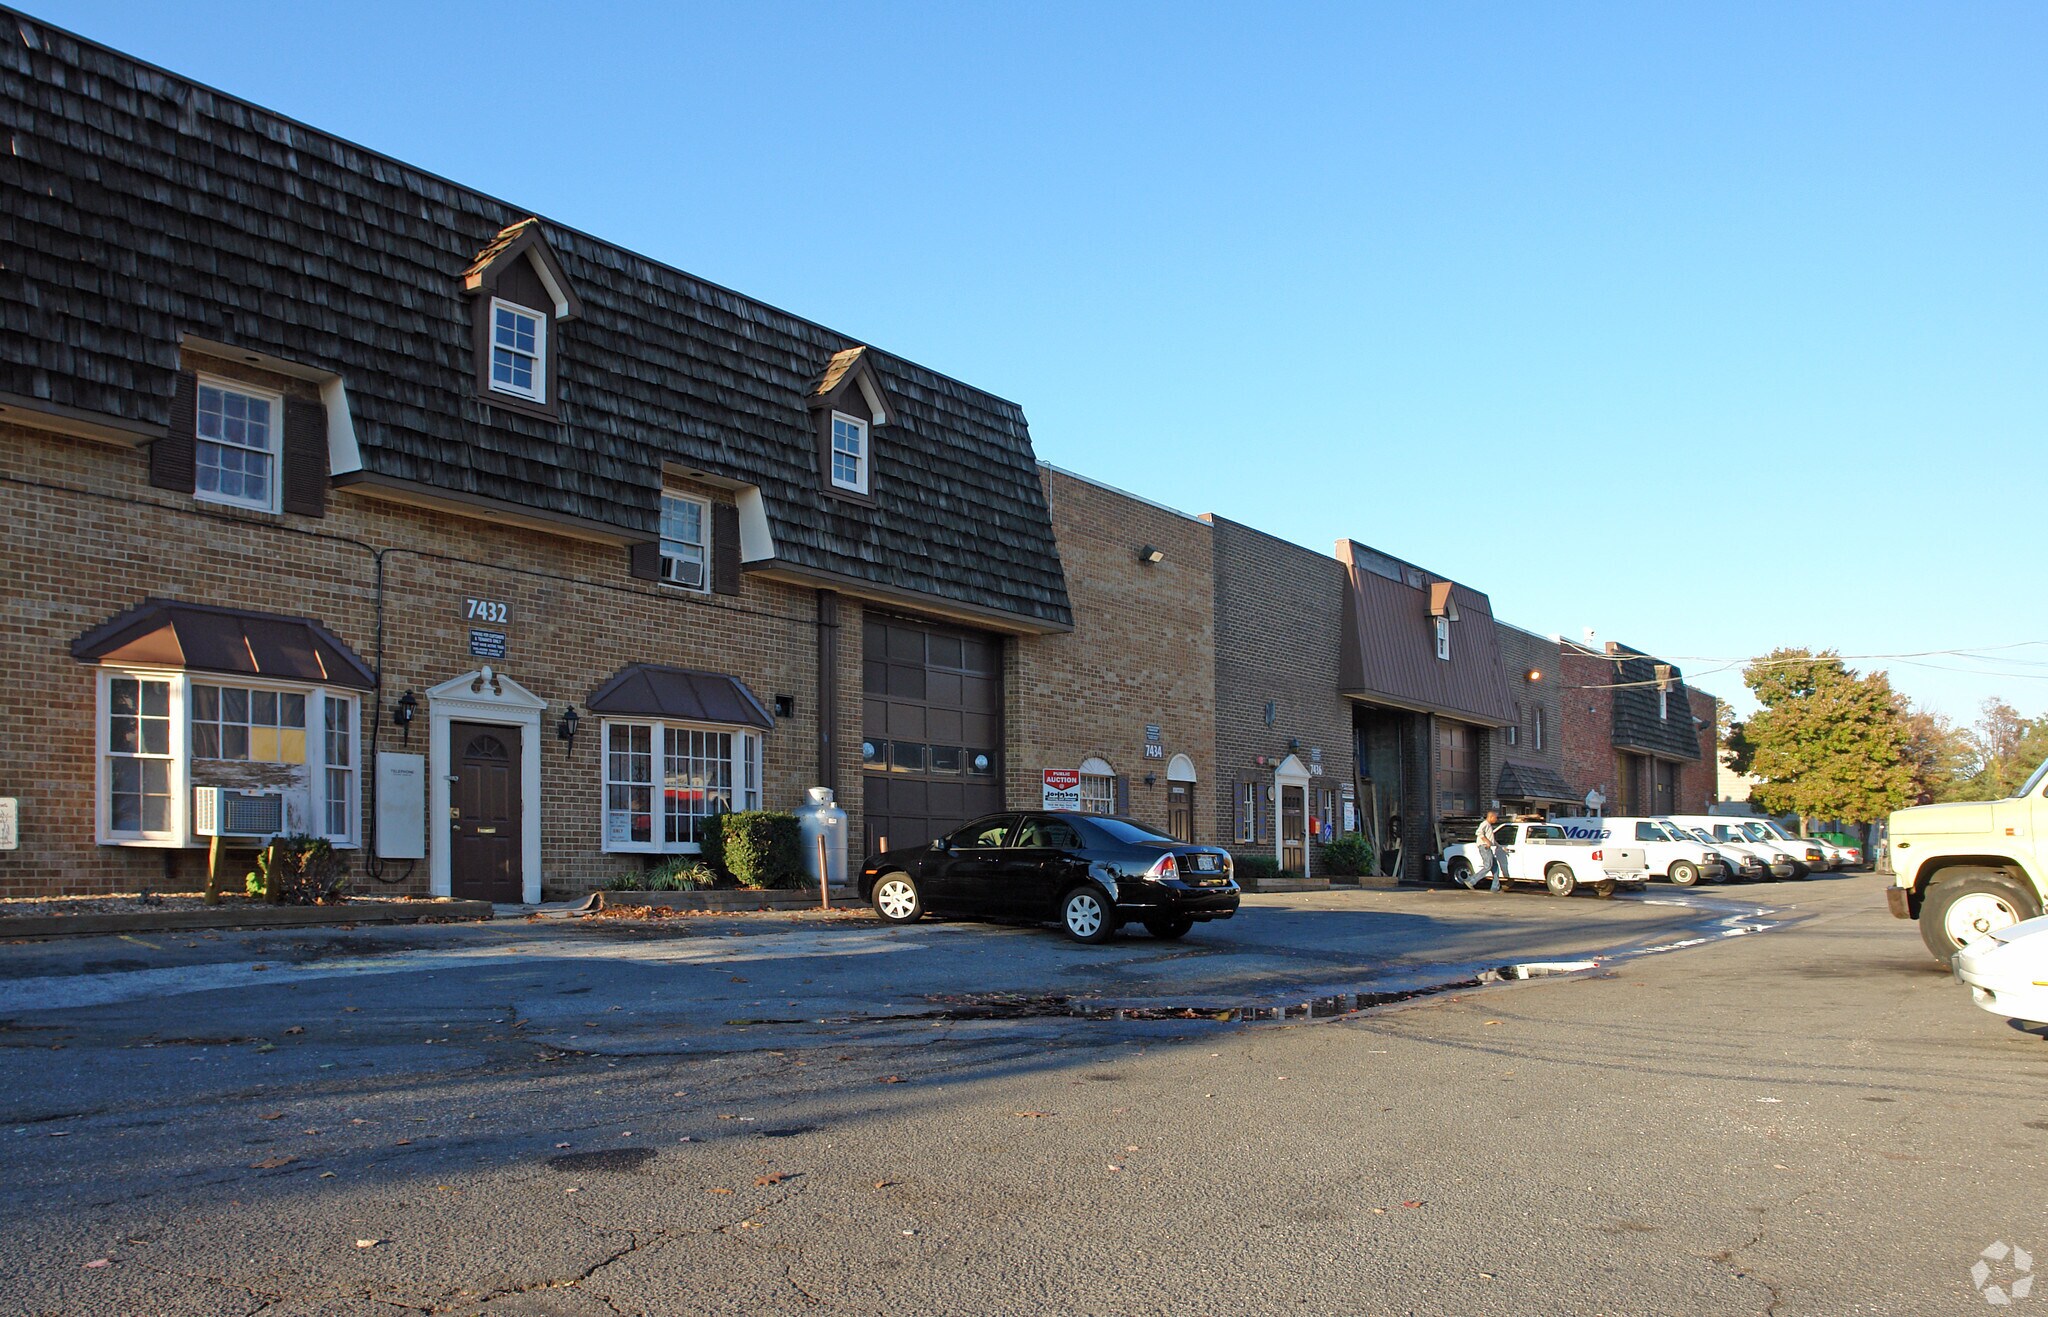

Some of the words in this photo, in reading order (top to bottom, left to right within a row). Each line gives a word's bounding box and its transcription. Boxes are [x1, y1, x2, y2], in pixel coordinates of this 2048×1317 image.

[467, 599, 507, 623] 7432
[1145, 745, 1162, 757] 7434
[1046, 776, 1077, 784] AUCTION
